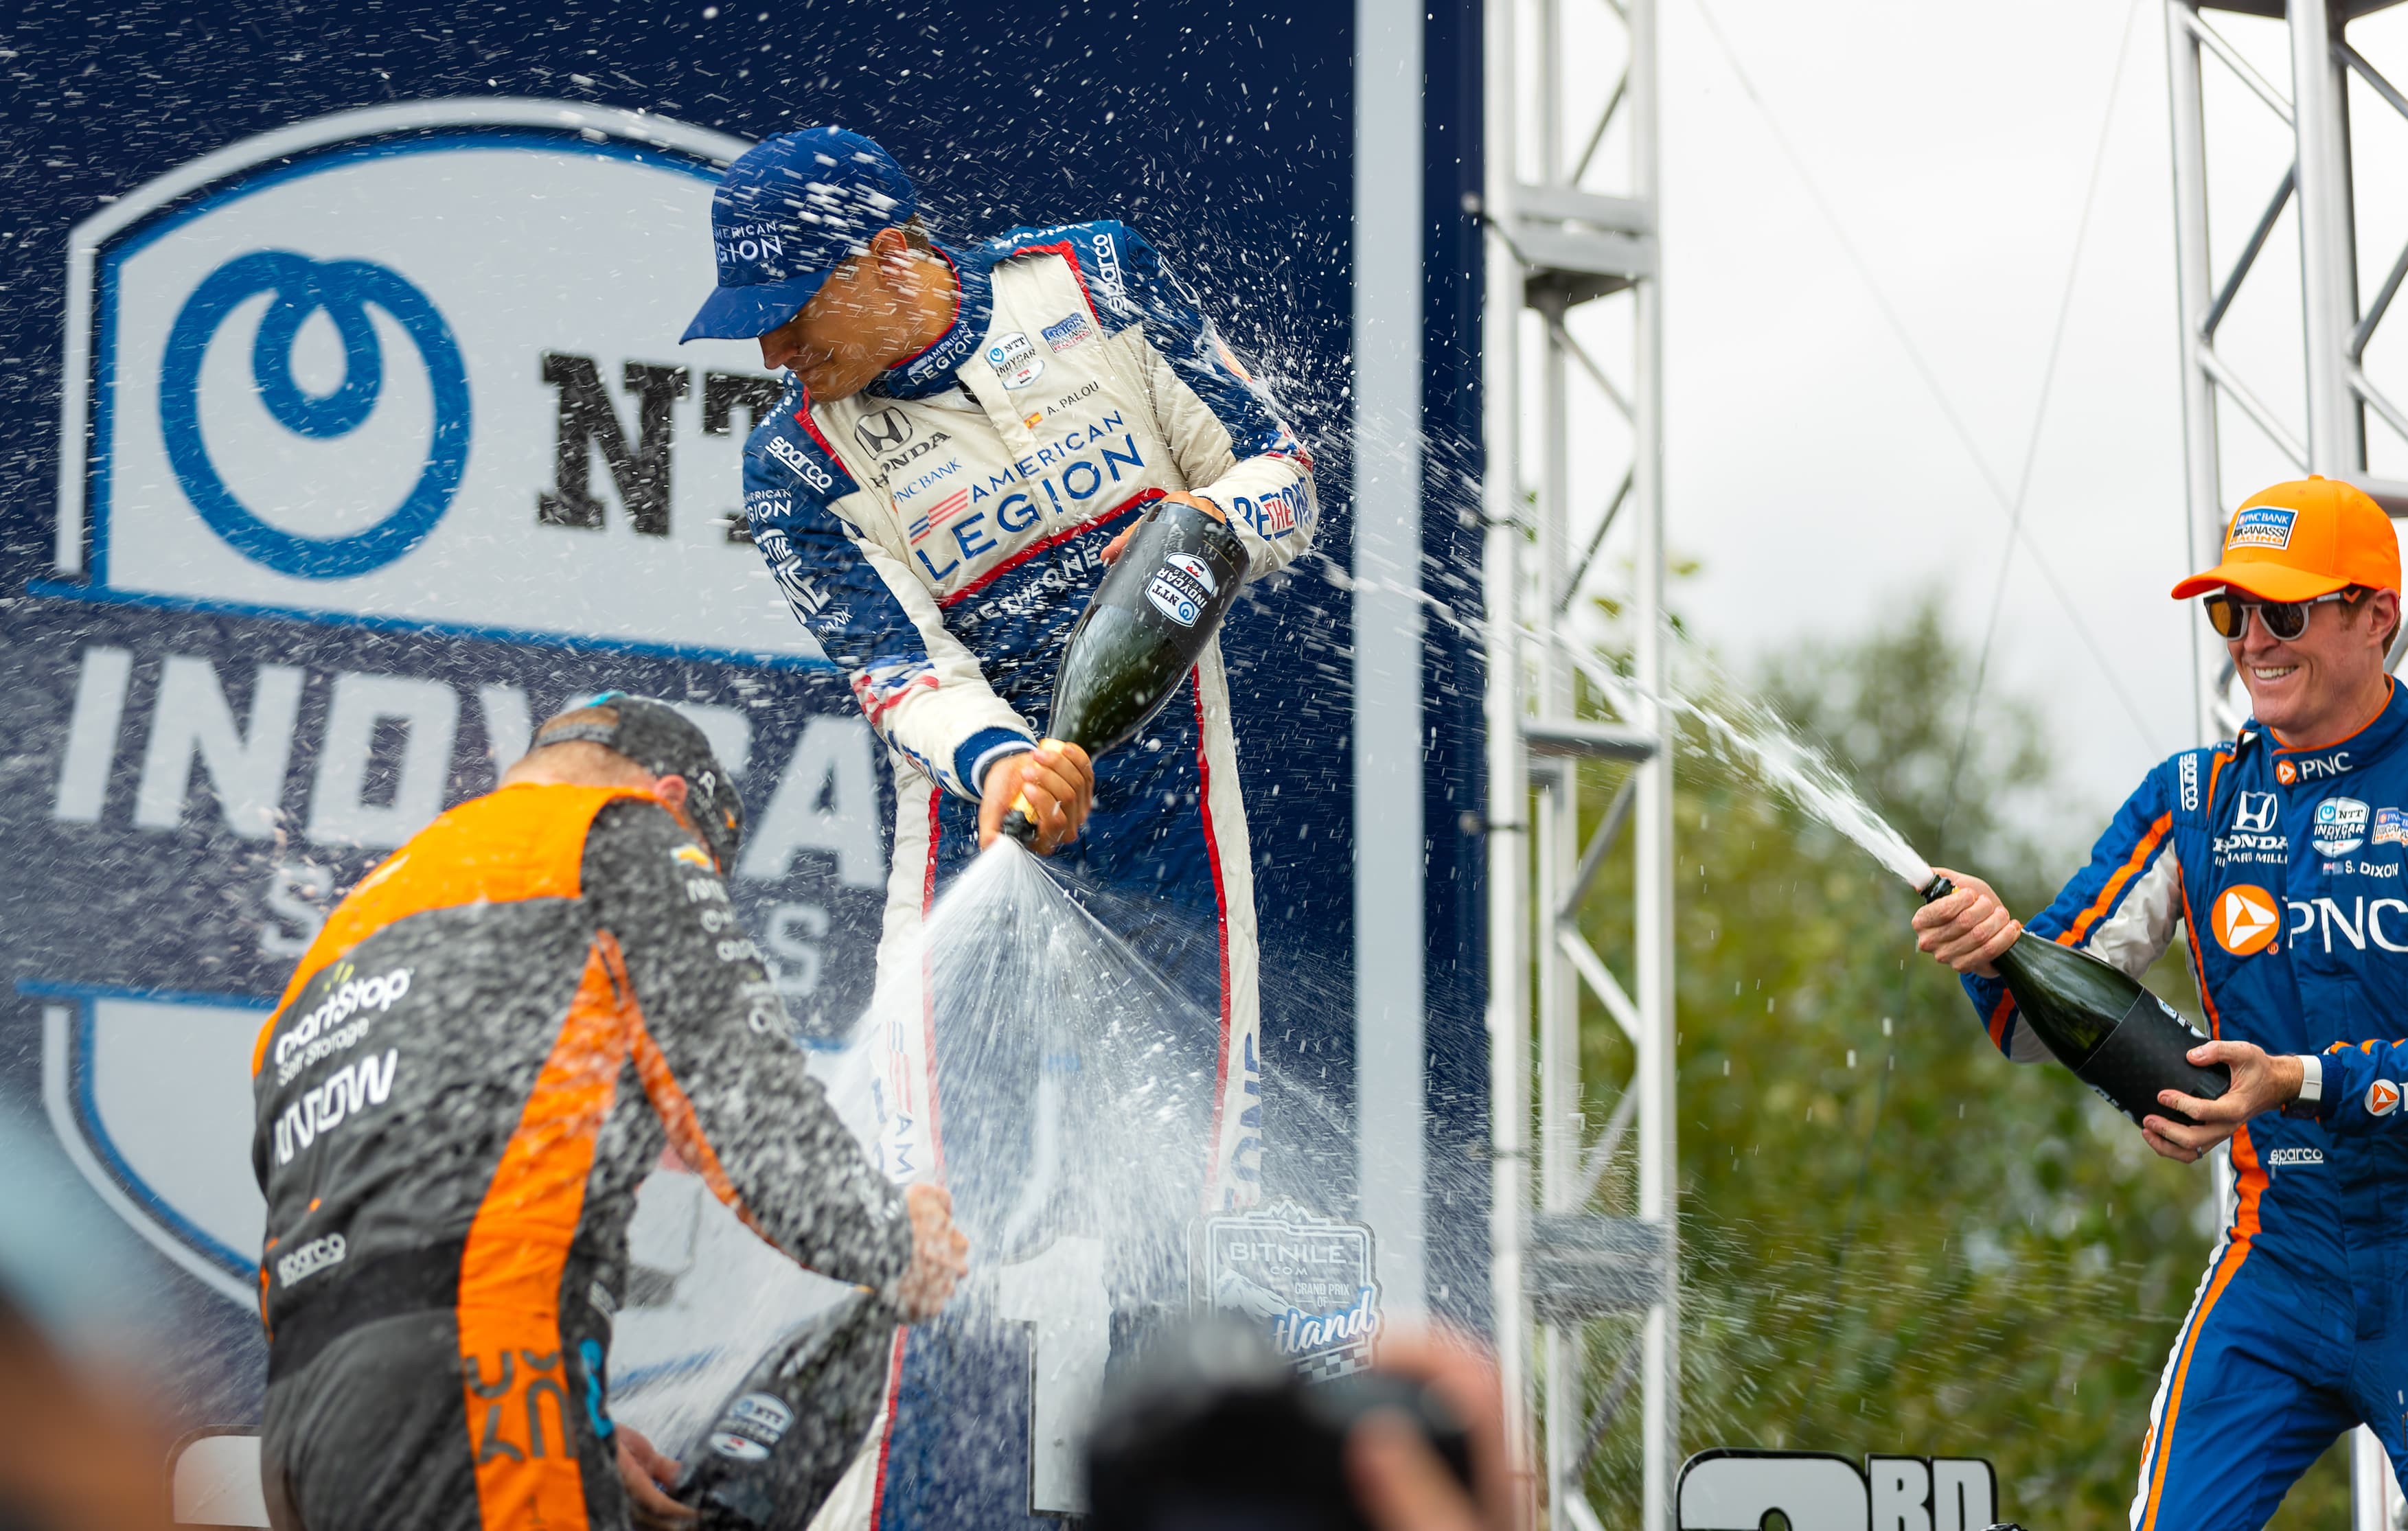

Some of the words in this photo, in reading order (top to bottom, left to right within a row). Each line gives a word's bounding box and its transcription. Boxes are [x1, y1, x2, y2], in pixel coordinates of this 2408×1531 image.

[715, 235, 783, 264] GION
[910, 327, 976, 386] LEGION
[1003, 336, 1027, 354] NTT
[996, 348, 1037, 378] INDYCAR
[1047, 406, 1059, 416] A.
[1059, 380, 1099, 408] PALOU
[765, 435, 833, 495] sparco
[869, 430, 952, 489] HONDA
[972, 408, 1125, 504] AMERICAN
[918, 457, 963, 489] BANK
[744, 499, 792, 524] GION
[915, 433, 1147, 582] LEGION
[1264, 499, 1294, 531] THE
[2261, 512, 2289, 525] BANK
[1042, 548, 1104, 588] ONE
[1173, 568, 1204, 593] SERIES
[1151, 584, 1180, 606] NTT
[1156, 567, 1208, 609] INDYCAR
[2299, 752, 2352, 780] PNC
[2339, 809, 2363, 819] NTT
[2212, 833, 2289, 854] HONDA
[2313, 823, 2366, 837] INDYCAR
[2345, 860, 2355, 875] S.
[2359, 861, 2399, 879] DIXON
[2282, 895, 2408, 954] PNC
[304, 1017, 369, 1067] Storage
[2268, 1147, 2324, 1166] sparco
[1229, 1241, 1347, 1265] BITNILE
[1294, 1281, 1326, 1296] GRAND
[1328, 1282, 1350, 1296] PRIX
[1317, 1296, 1329, 1308] OF
[1272, 1286, 1375, 1357] tland
